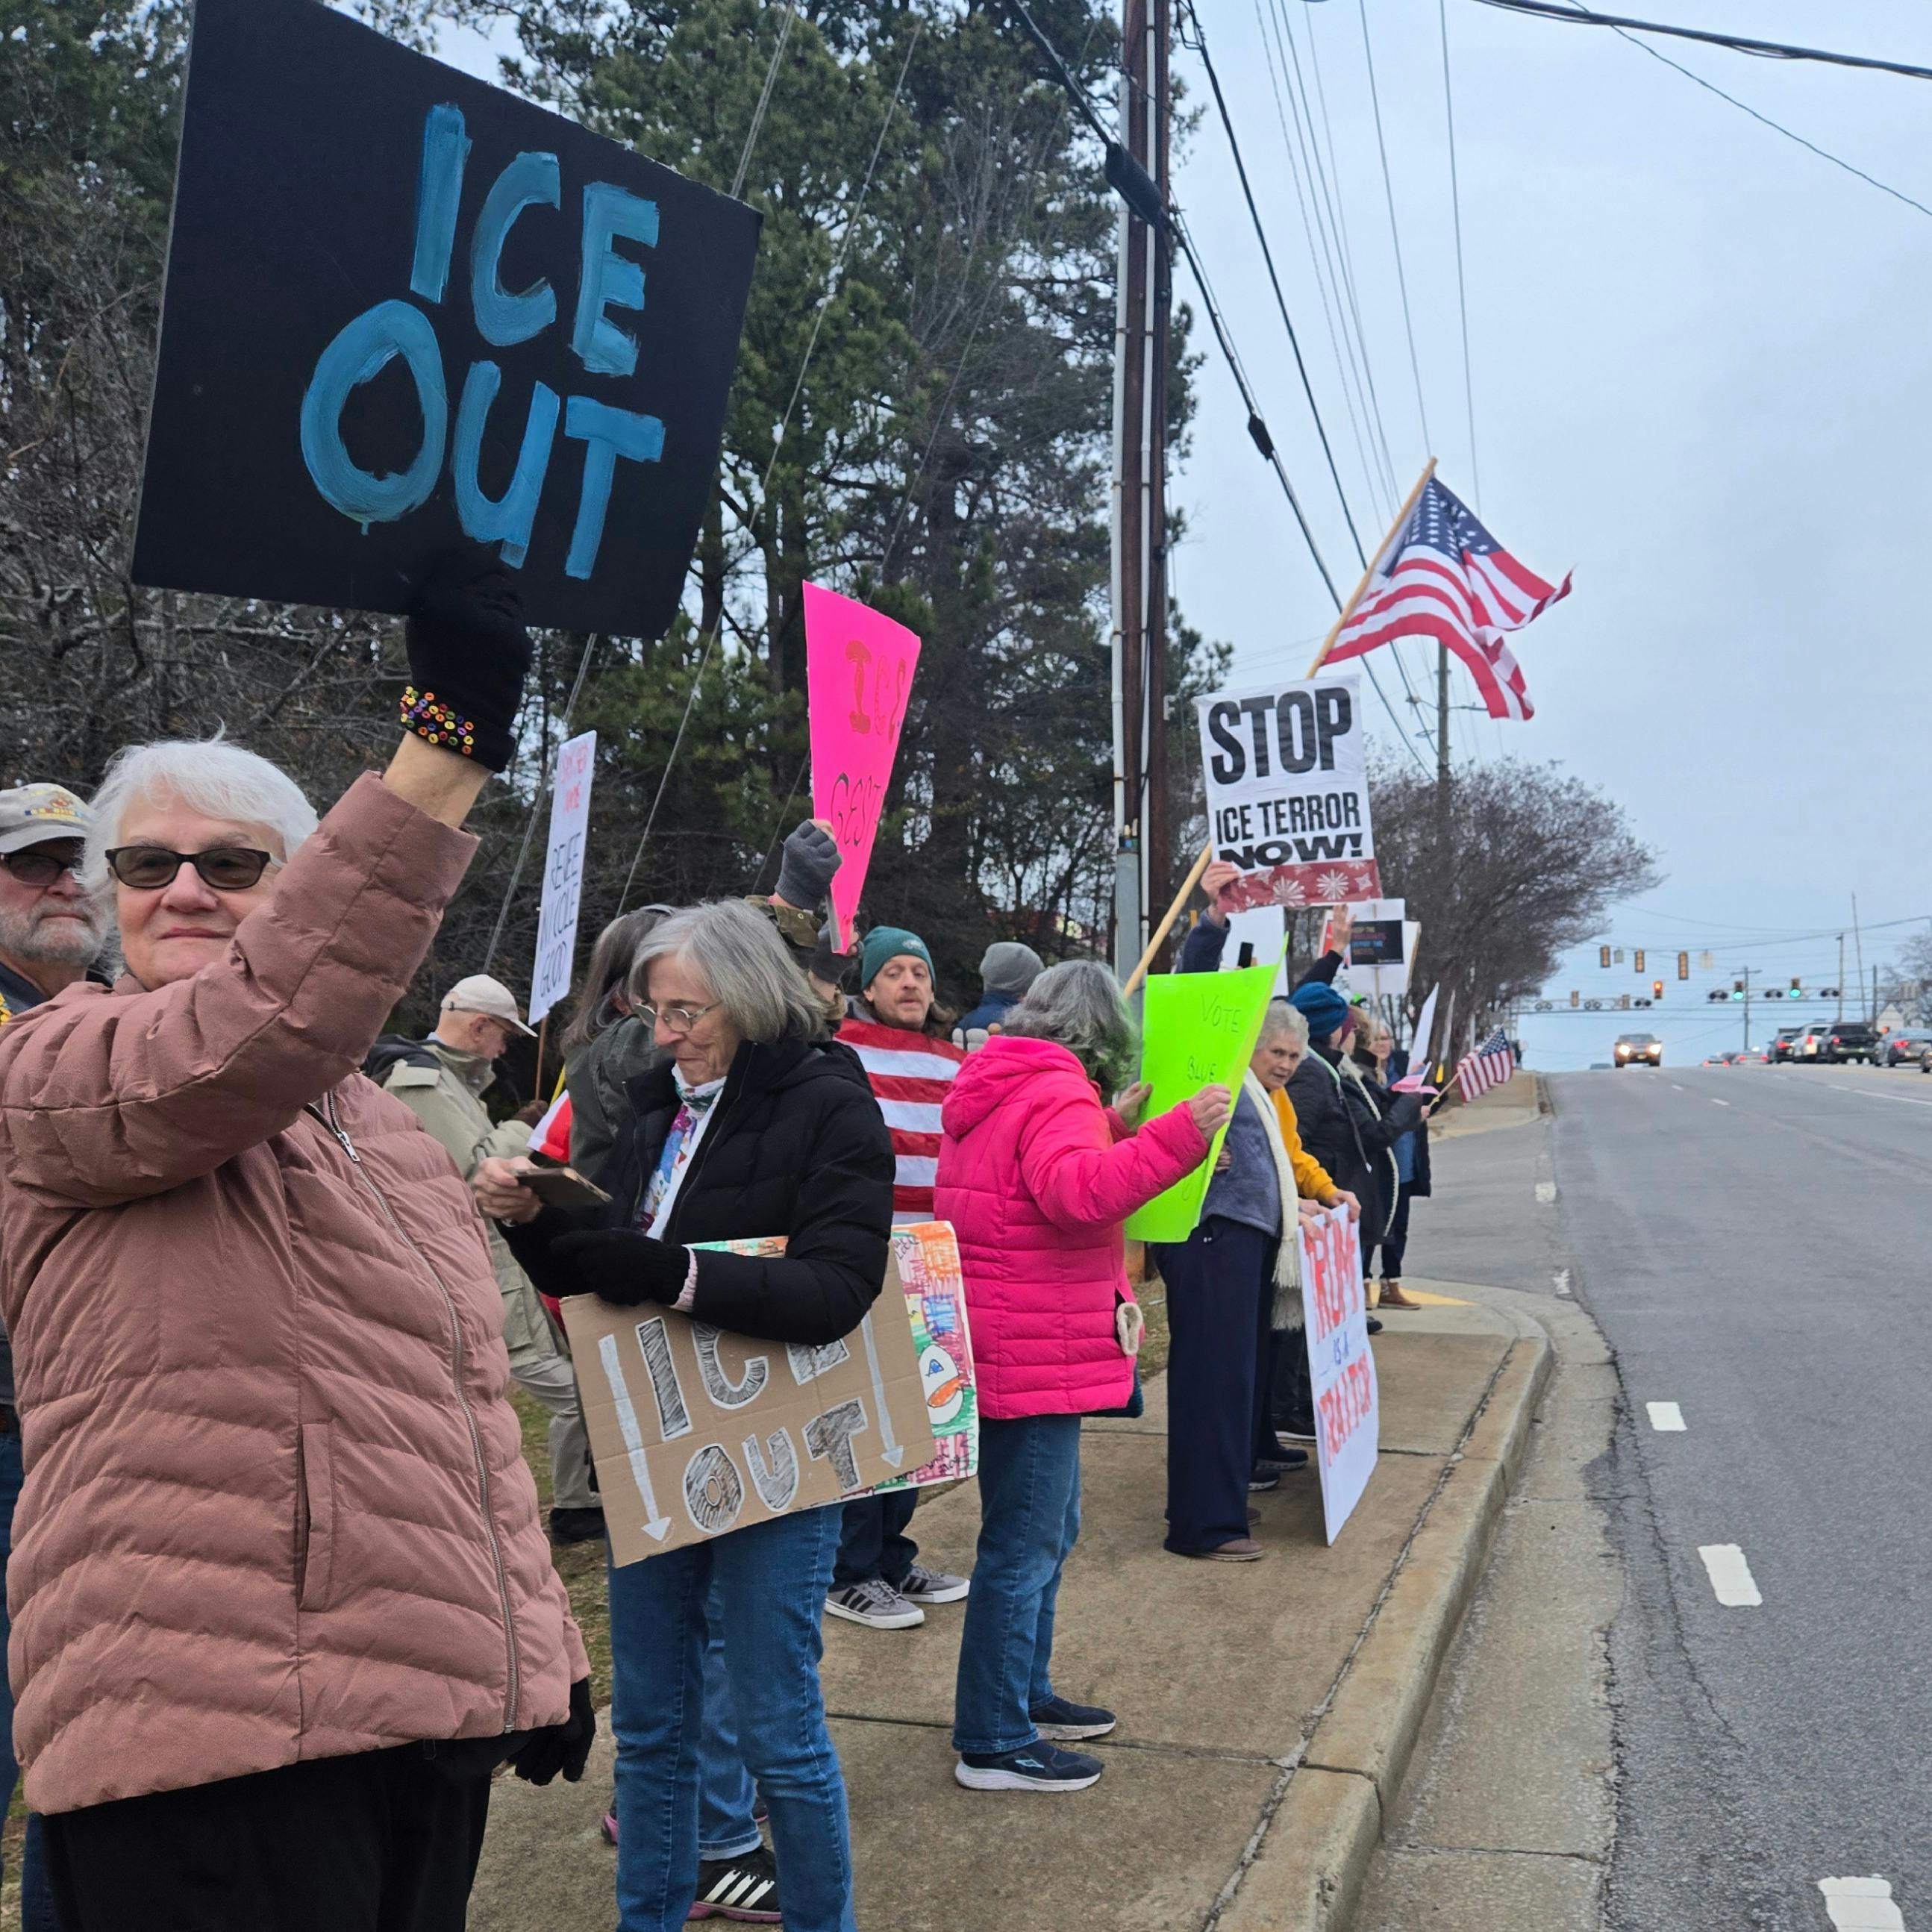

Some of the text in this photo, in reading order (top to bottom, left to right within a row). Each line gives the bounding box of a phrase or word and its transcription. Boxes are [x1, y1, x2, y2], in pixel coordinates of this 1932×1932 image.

[410, 102, 660, 376] ICE
[300, 298, 666, 580] OUT
[1207, 687, 1352, 785] STOP
[1215, 791, 1361, 845] ICE TERROR
[1219, 832, 1363, 871] NOW!
[1200, 992, 1242, 1033] VOTE
[1187, 1055, 1217, 1084] BLUE
[682, 1396, 869, 1534] OUT
